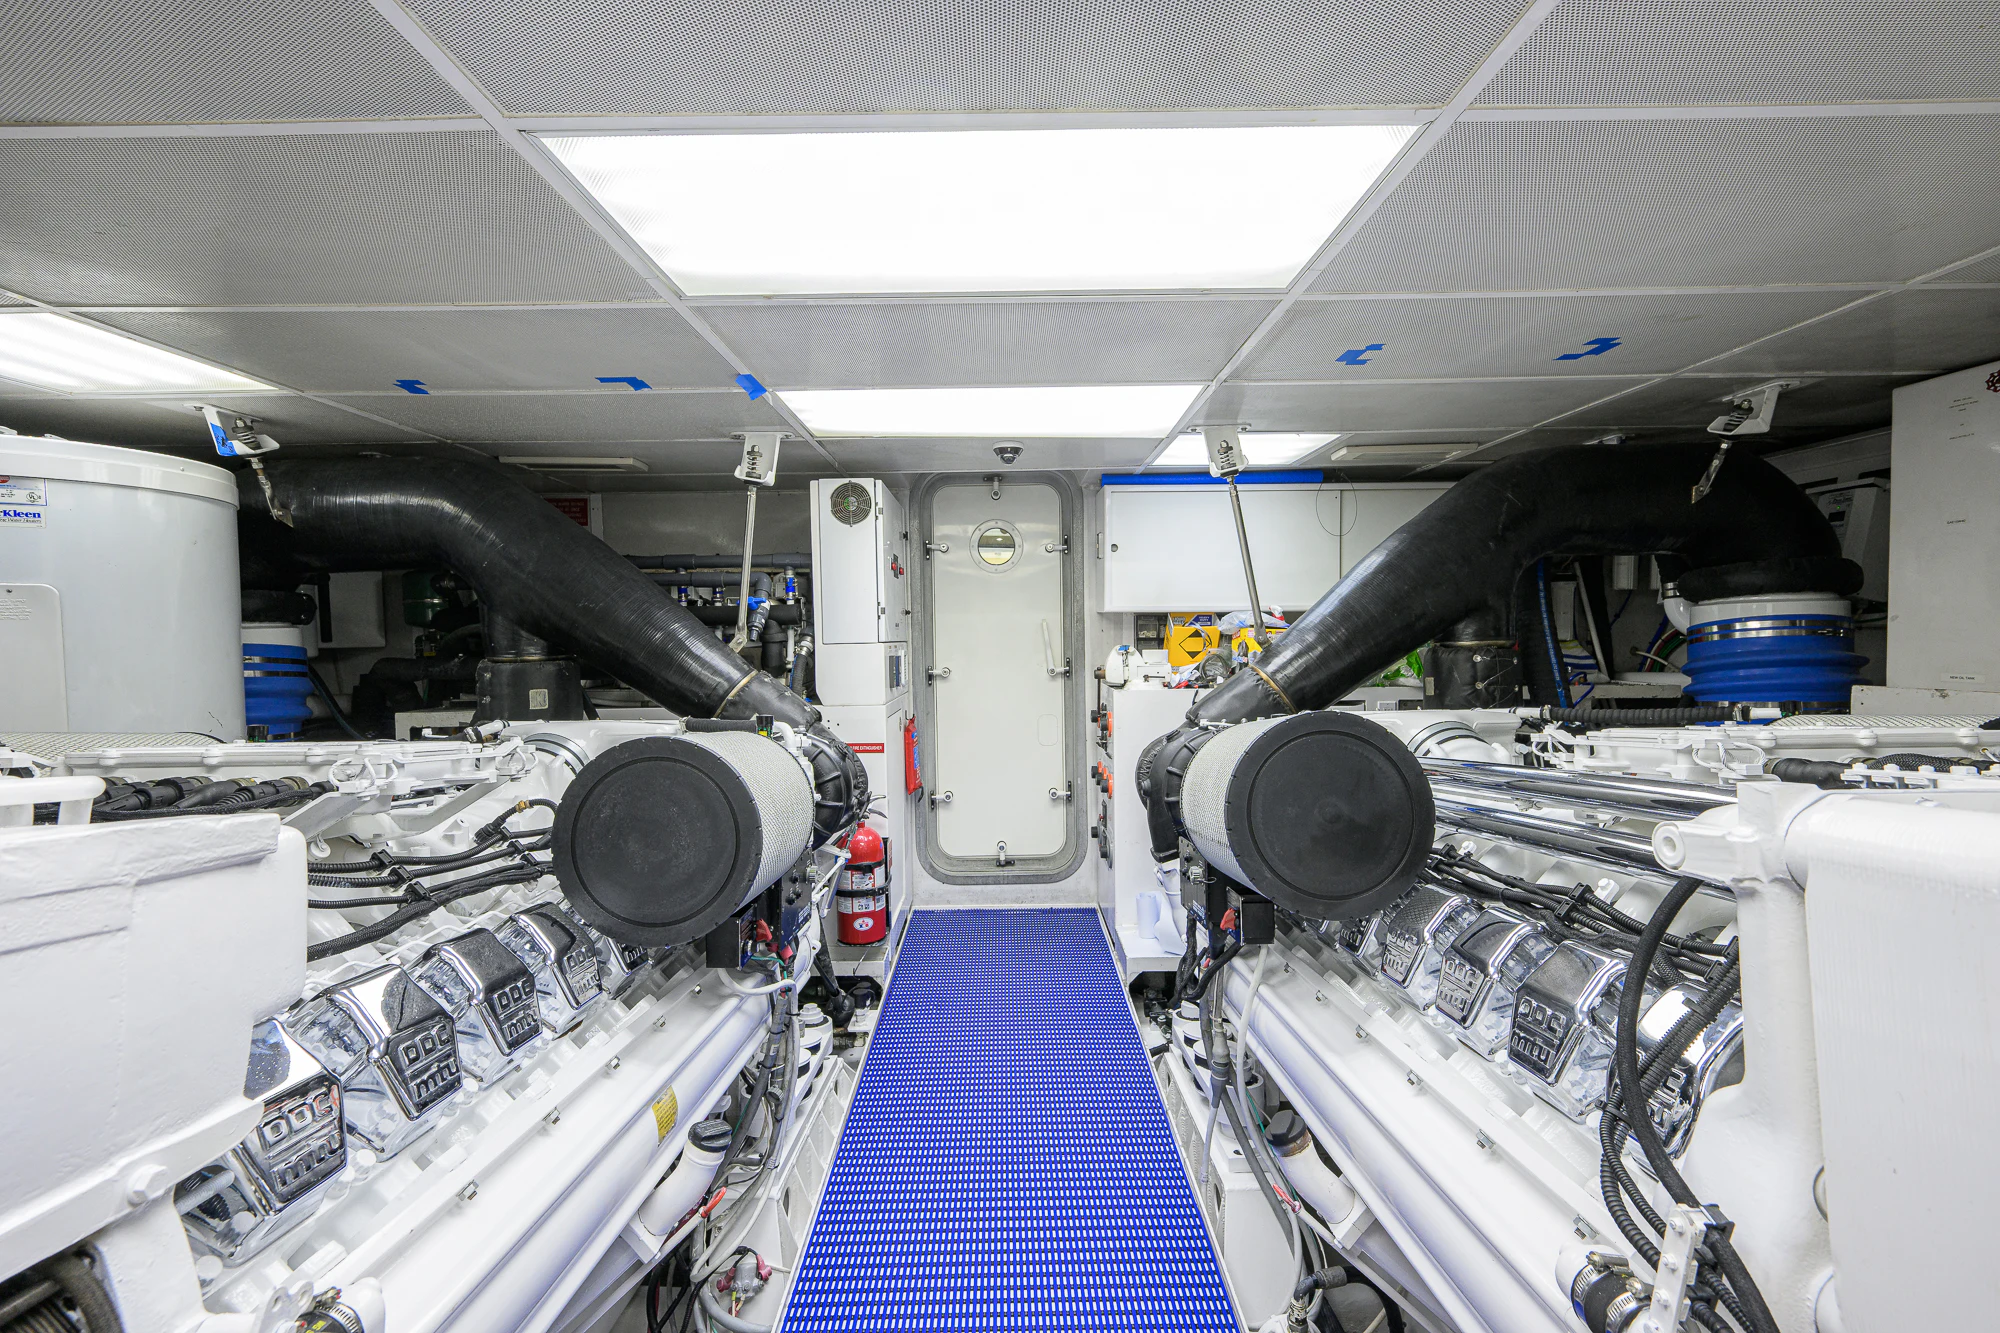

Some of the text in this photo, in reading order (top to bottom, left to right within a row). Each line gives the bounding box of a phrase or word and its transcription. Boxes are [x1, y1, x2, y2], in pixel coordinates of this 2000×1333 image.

[1445, 957, 1479, 990] DDC
[493, 977, 534, 1014] DDC
[1438, 986, 1470, 1015] mtu
[502, 1007, 538, 1041] mtu
[1518, 997, 1566, 1037] DDC
[399, 1023, 452, 1070] DDC
[1510, 1030, 1555, 1069] mtu
[409, 1057, 461, 1102] mtu
[261, 1088, 338, 1150] DDC
[271, 1132, 342, 1191] mtu
